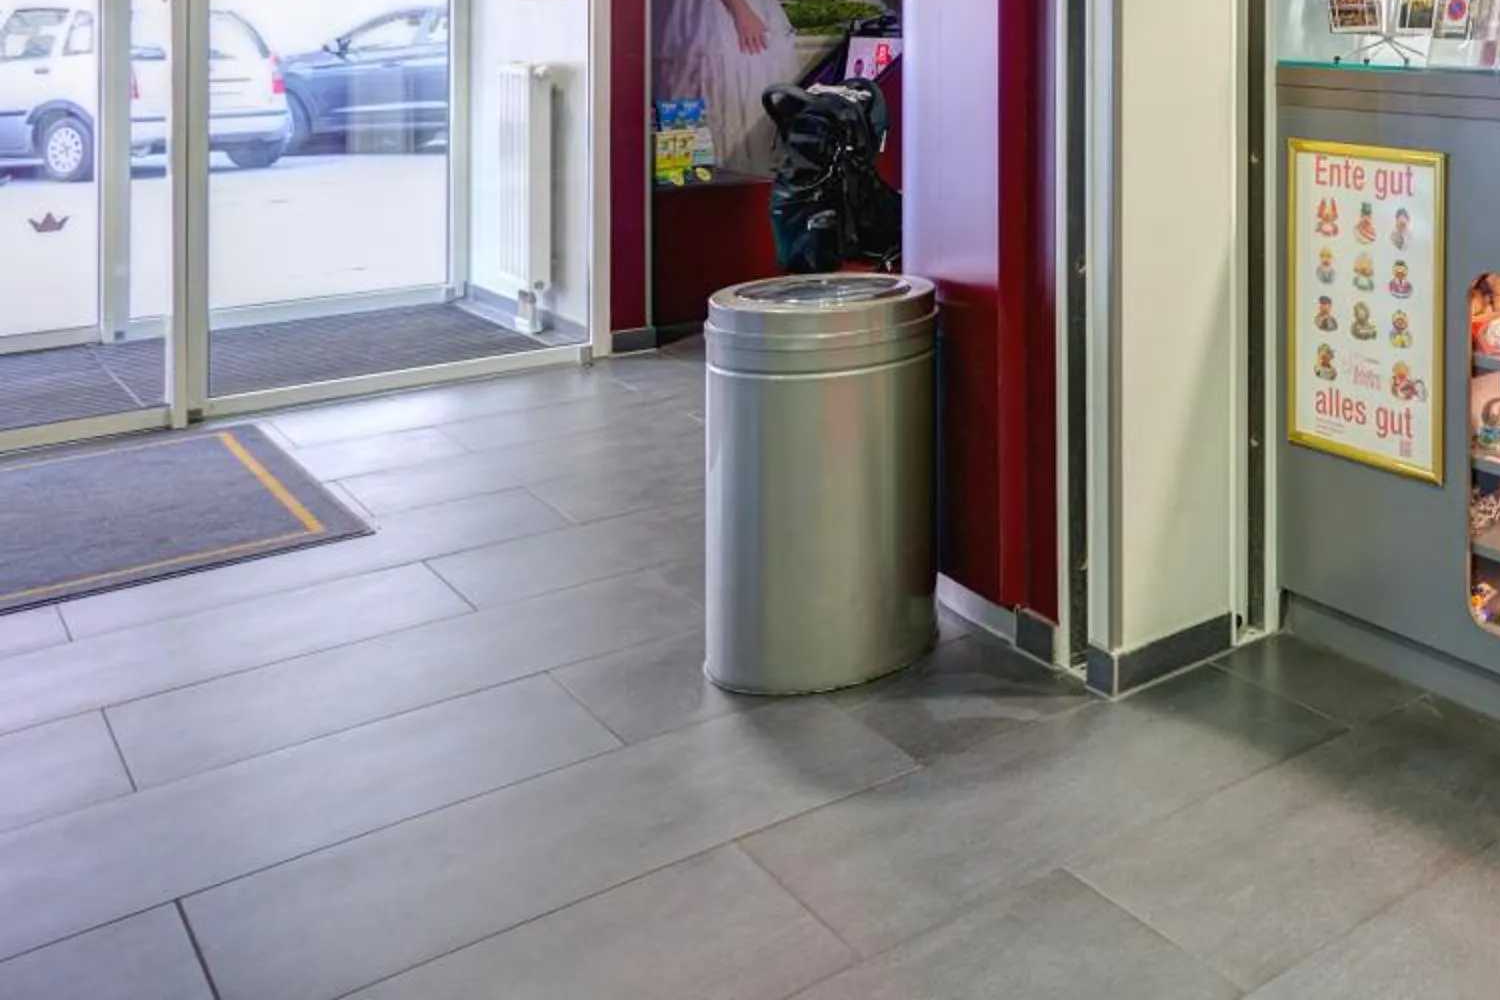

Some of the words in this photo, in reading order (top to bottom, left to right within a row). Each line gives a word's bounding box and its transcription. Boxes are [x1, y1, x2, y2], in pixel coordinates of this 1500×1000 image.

[1315, 153, 1365, 192] Ente
[1375, 165, 1414, 201] gut
[1315, 387, 1367, 425] alles
[1376, 406, 1413, 439] gut
